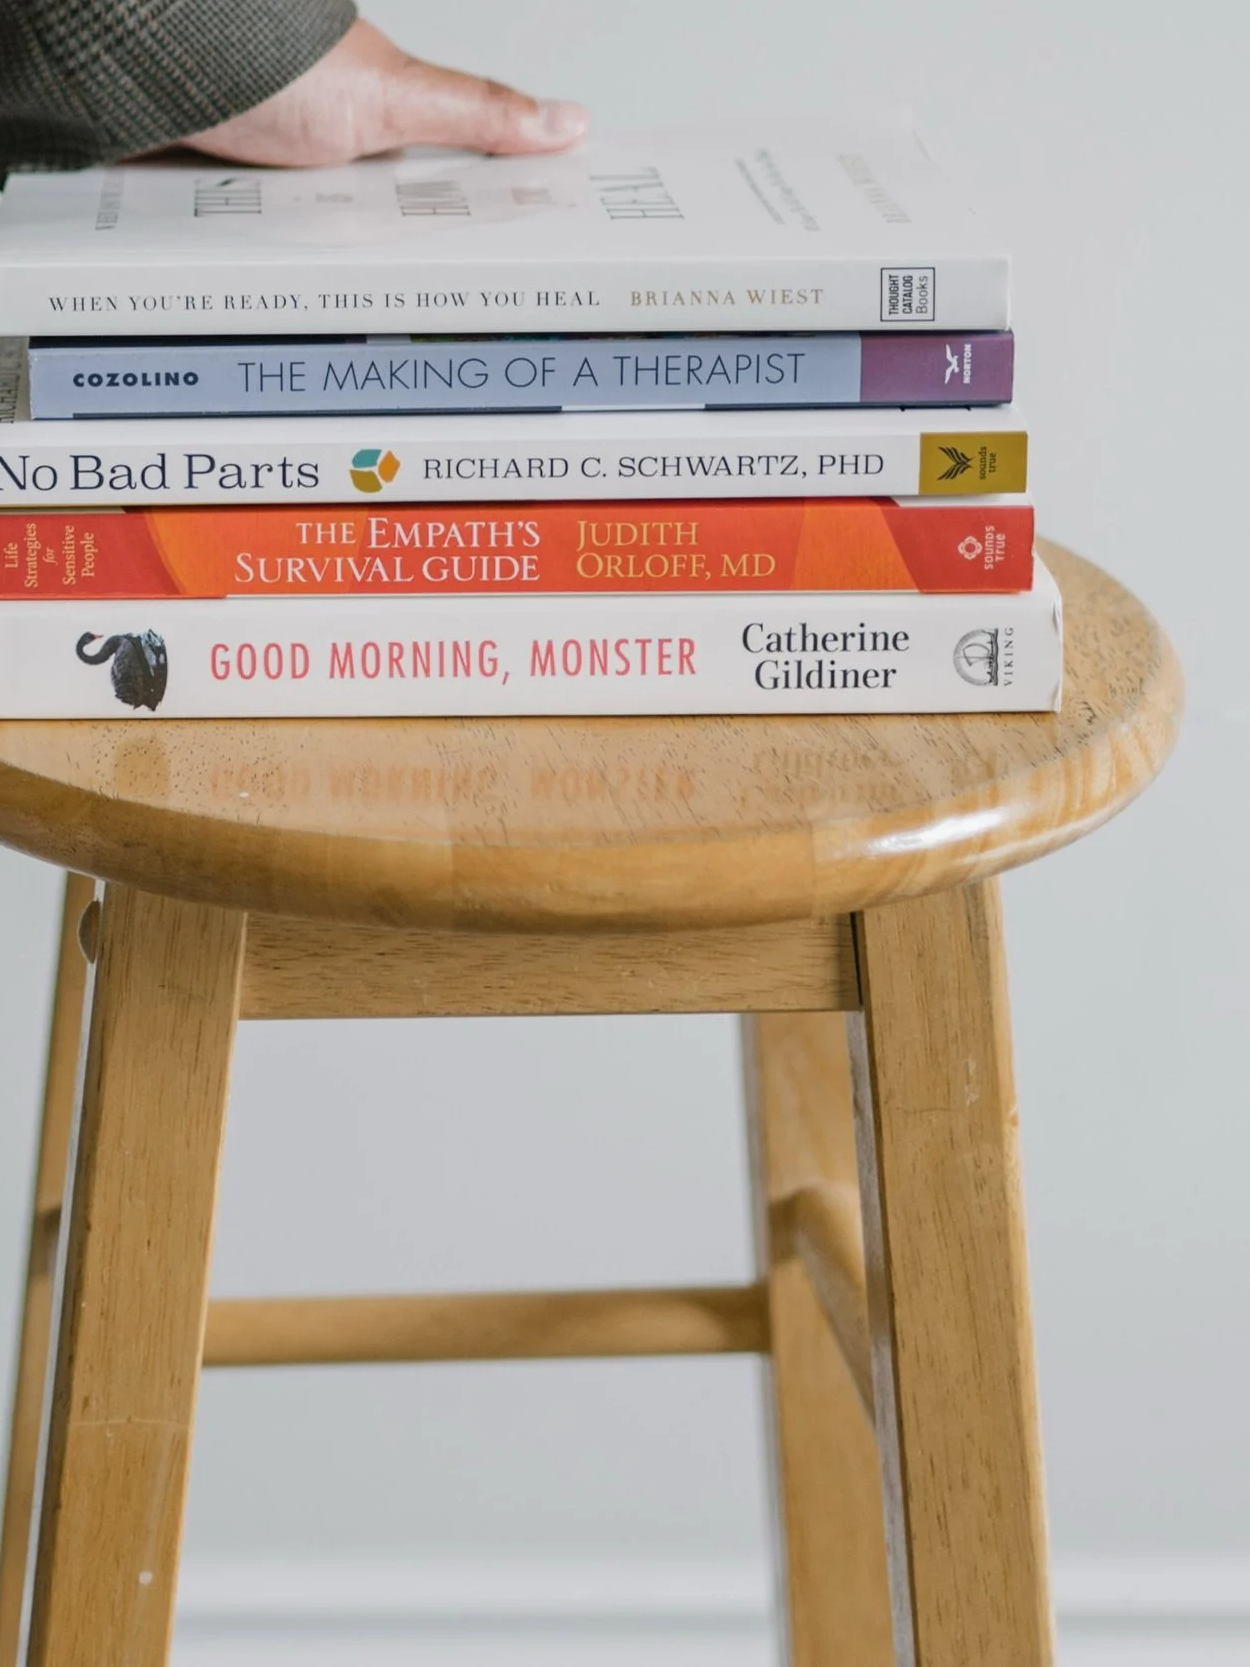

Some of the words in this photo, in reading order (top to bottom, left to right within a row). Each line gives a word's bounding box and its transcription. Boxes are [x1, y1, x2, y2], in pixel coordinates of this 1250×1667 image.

[50, 297, 116, 311] WHEN
[130, 296, 212, 310] YOU'RE
[225, 295, 307, 311] READY,
[319, 294, 372, 308] THIS
[386, 294, 404, 307] IS
[416, 293, 469, 307] HOW
[480, 292, 525, 306] YOU
[538, 291, 599, 306] HEAL
[631, 291, 735, 306] BRIANNA
[747, 289, 823, 304] WIEST
[889, 275, 899, 315] THOUGHT
[903, 276, 913, 314] CATALOG
[916, 276, 928, 313] Books
[238, 362, 305, 392] THE
[324, 358, 488, 390] MAKING
[505, 357, 555, 387] OF
[573, 357, 598, 386] A
[614, 353, 805, 386] THERAPIST
[962, 344, 973, 383] NORTON
[73, 372, 198, 387] COZOLINO
[70, 453, 169, 490] Bad
[184, 454, 318, 489] Parts
[425, 458, 568, 478] RICHARD
[581, 457, 606, 477] C.
[619, 456, 806, 478] SCHWARTZ,
[819, 455, 883, 474] PHD
[978, 446, 988, 479] sounds
[989, 453, 997, 473] true
[297, 523, 355, 543] THE
[369, 518, 540, 548] EMPATH'S
[577, 521, 698, 551] JUDITH
[5, 543, 18, 567] Life
[24, 523, 39, 587] Strategies
[42, 547, 57, 565] for
[62, 526, 75, 584] Sensitive
[80, 533, 98, 576] People
[236, 553, 413, 582] SURVIVAL
[422, 556, 539, 581] GUIDE
[577, 553, 711, 580] ORLOFF,
[722, 554, 775, 576] MD
[743, 623, 909, 652] Catherine
[211, 643, 309, 680] GOOD
[330, 641, 509, 685] MORNING,
[531, 638, 695, 676] MONSTER
[1004, 628, 1013, 686] VIKING
[755, 660, 896, 689] Gildiner
